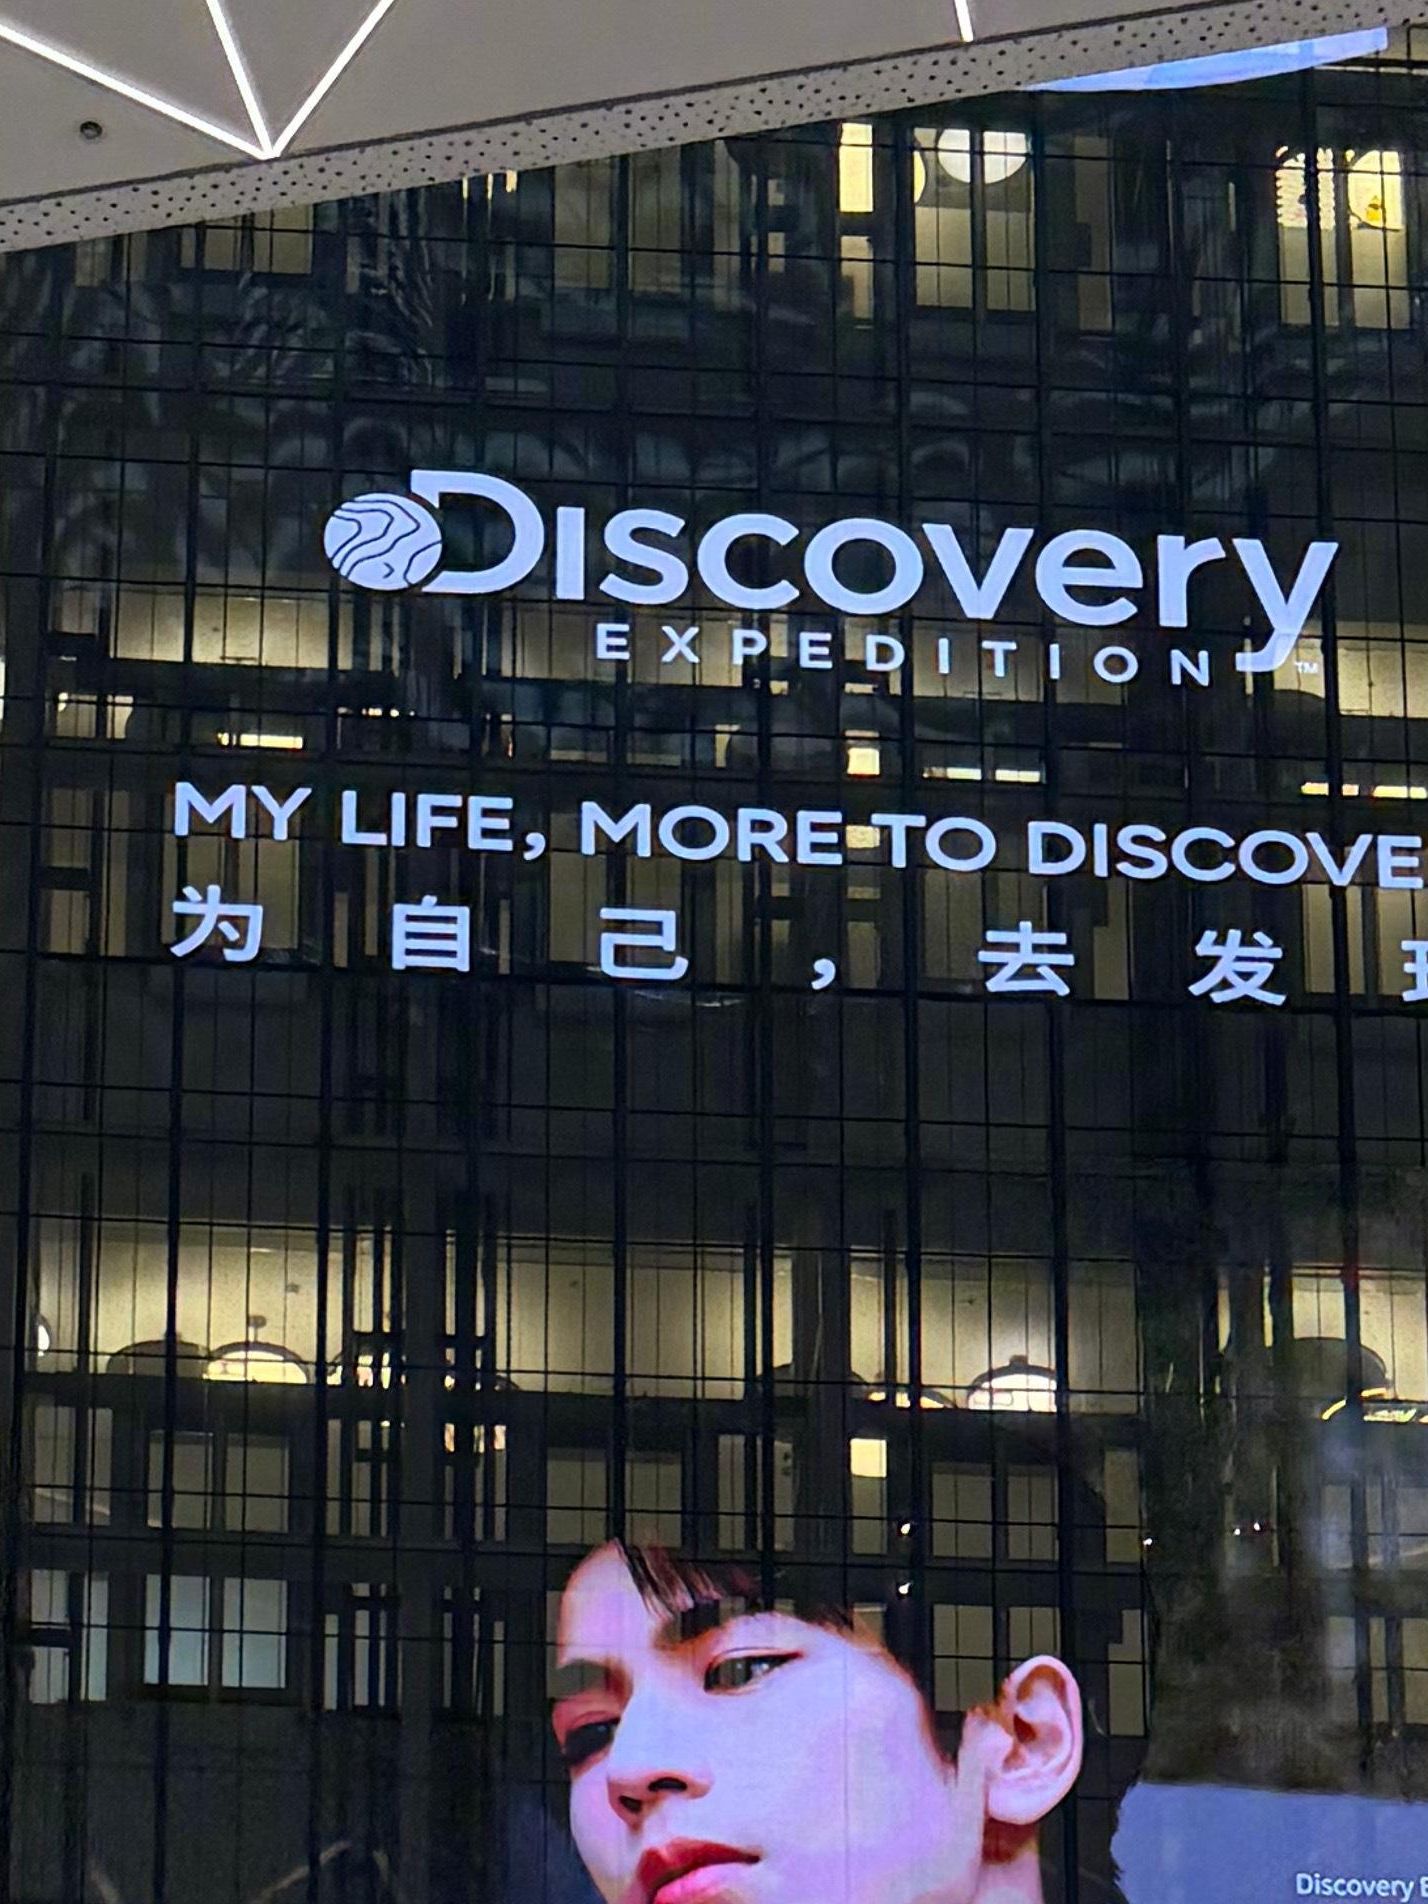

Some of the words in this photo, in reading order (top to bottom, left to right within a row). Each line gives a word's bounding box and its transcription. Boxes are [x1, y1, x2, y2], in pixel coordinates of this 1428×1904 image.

[410, 470, 1339, 673] Discovery
[596, 623, 1209, 687] EXPEDITION
[174, 782, 312, 841] MY
[342, 790, 546, 861] LIFE,
[581, 801, 843, 865] MORE
[871, 813, 996, 871] TO
[1296, 1873, 1414, 1902] Discovery
